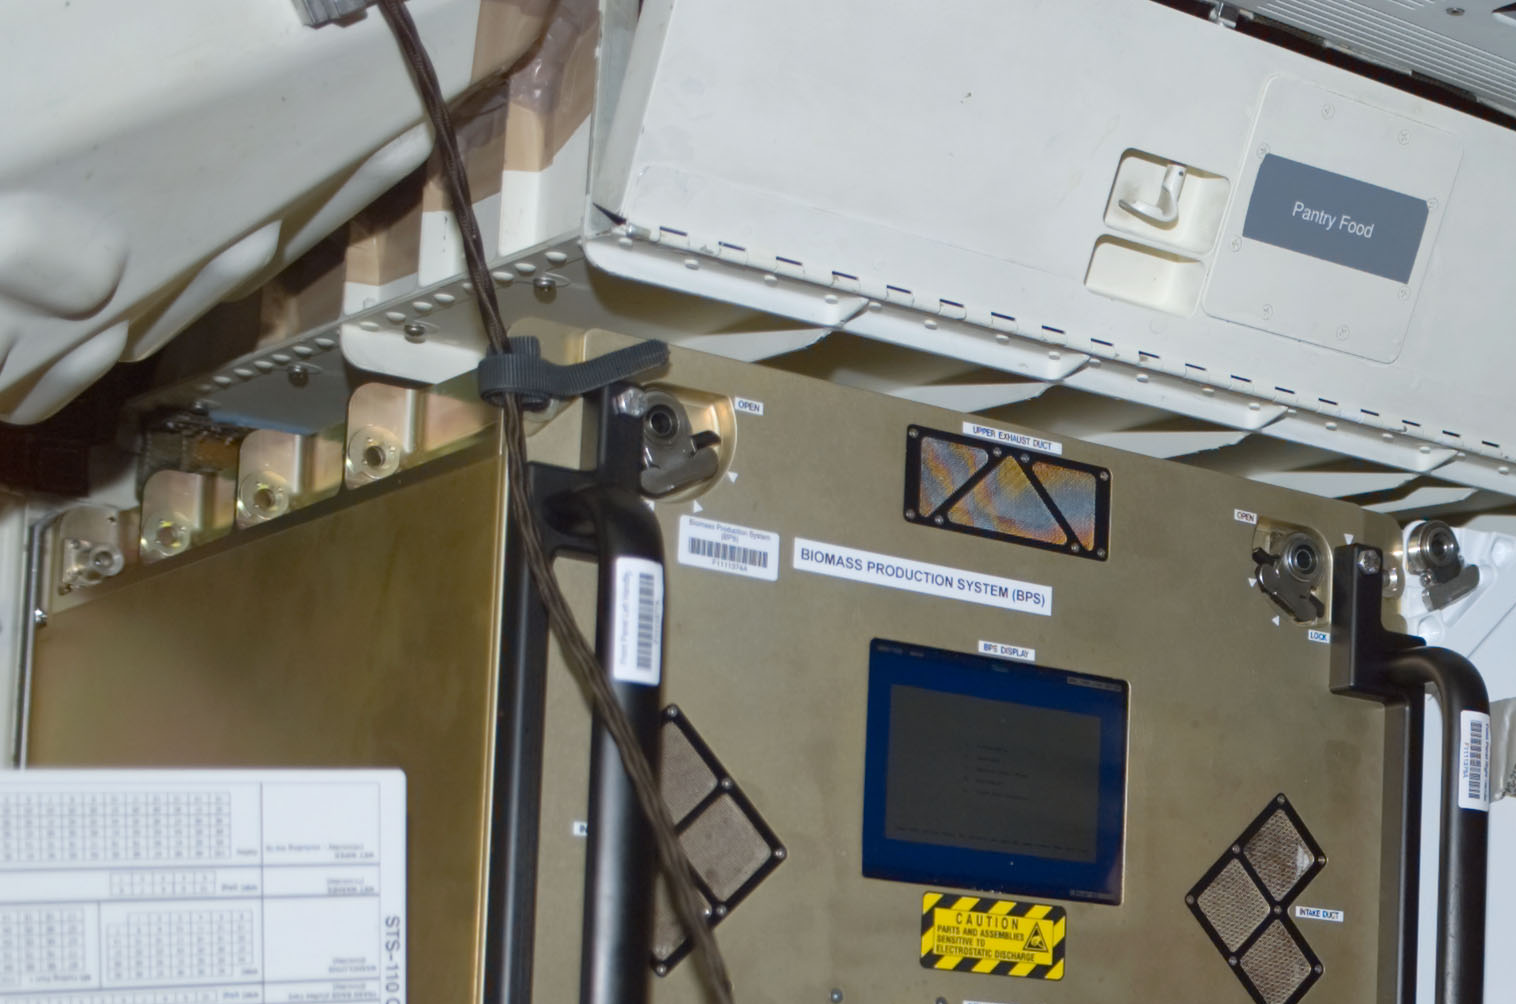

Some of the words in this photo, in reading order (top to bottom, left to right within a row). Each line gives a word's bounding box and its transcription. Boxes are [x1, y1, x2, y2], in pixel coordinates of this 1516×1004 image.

[1292, 201, 1336, 231] Pantry
[1339, 215, 1376, 238] Food
[738, 400, 760, 412] OPEN
[972, 425, 996, 438] UPPER
[998, 431, 1031, 445] EXHAUST
[1032, 439, 1052, 451] DUCT
[1236, 511, 1254, 522] OPEN
[800, 547, 863, 572] BIOMASS
[866, 560, 954, 589] PRODUCTION
[956, 577, 1009, 599] SYSTEM
[1012, 588, 1046, 608] (BPS)
[1310, 634, 1327, 642] LOCK
[1000, 646, 1030, 658] DISPLAY
[956, 912, 1019, 930] CAUTION
[1300, 909, 1320, 918] INTAKE
[1322, 911, 1340, 920] DUCT
[936, 924, 960, 934] PARTS
[963, 927, 977, 937] AND
[980, 930, 1024, 942] ASSEMBLIES
[936, 935, 973, 944] SENSITIVE
[383, 916, 401, 992] STS-110
[936, 946, 992, 958] ELECTROSTATIC
[994, 952, 1034, 962] DISCHARGE
